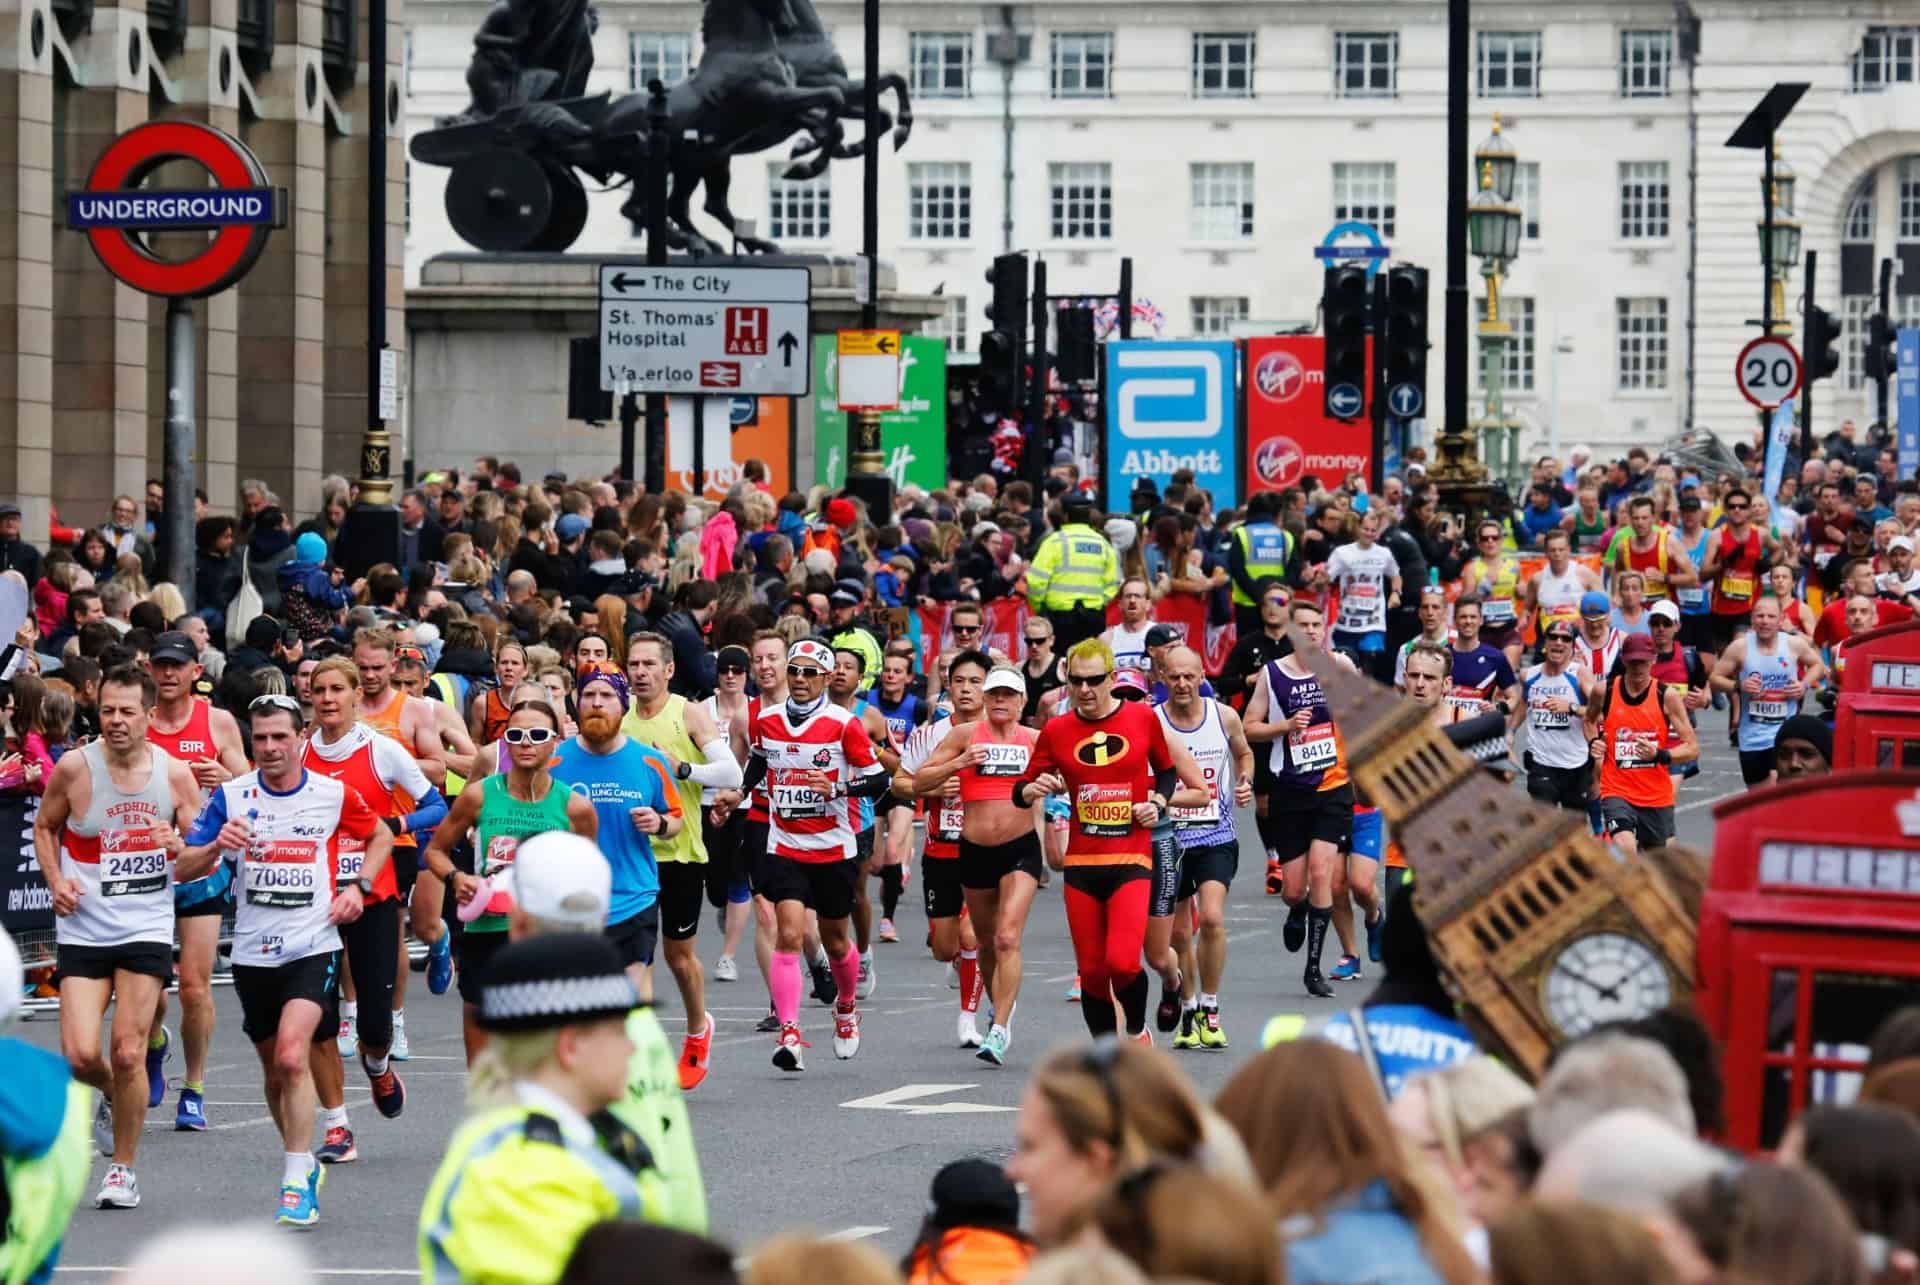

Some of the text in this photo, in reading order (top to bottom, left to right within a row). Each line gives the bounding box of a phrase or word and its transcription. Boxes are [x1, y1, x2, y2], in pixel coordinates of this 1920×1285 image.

[79, 196, 262, 220] UNDERGROUND
[652, 275, 731, 294] The City
[609, 310, 719, 326] St. Thomas'
[734, 308, 760, 340] H
[608, 331, 687, 349] Hospital
[1256, 362, 1301, 394] Virgin
[1747, 358, 1793, 388] 20
[1120, 449, 1222, 475] Abbott
[1257, 447, 1367, 479] Virgin money
[178, 740, 205, 753] BTR
[1301, 742, 1332, 760] 8412
[591, 788, 643, 799] LUNG CANCER
[1101, 789, 1129, 798] money
[105, 801, 158, 818] REDHILL
[1085, 805, 1129, 821] 30092
[277, 847, 314, 858] money
[109, 854, 165, 876] 24239
[336, 857, 362, 874] 96
[253, 868, 313, 887] 70886
[8, 888, 24, 911] new
